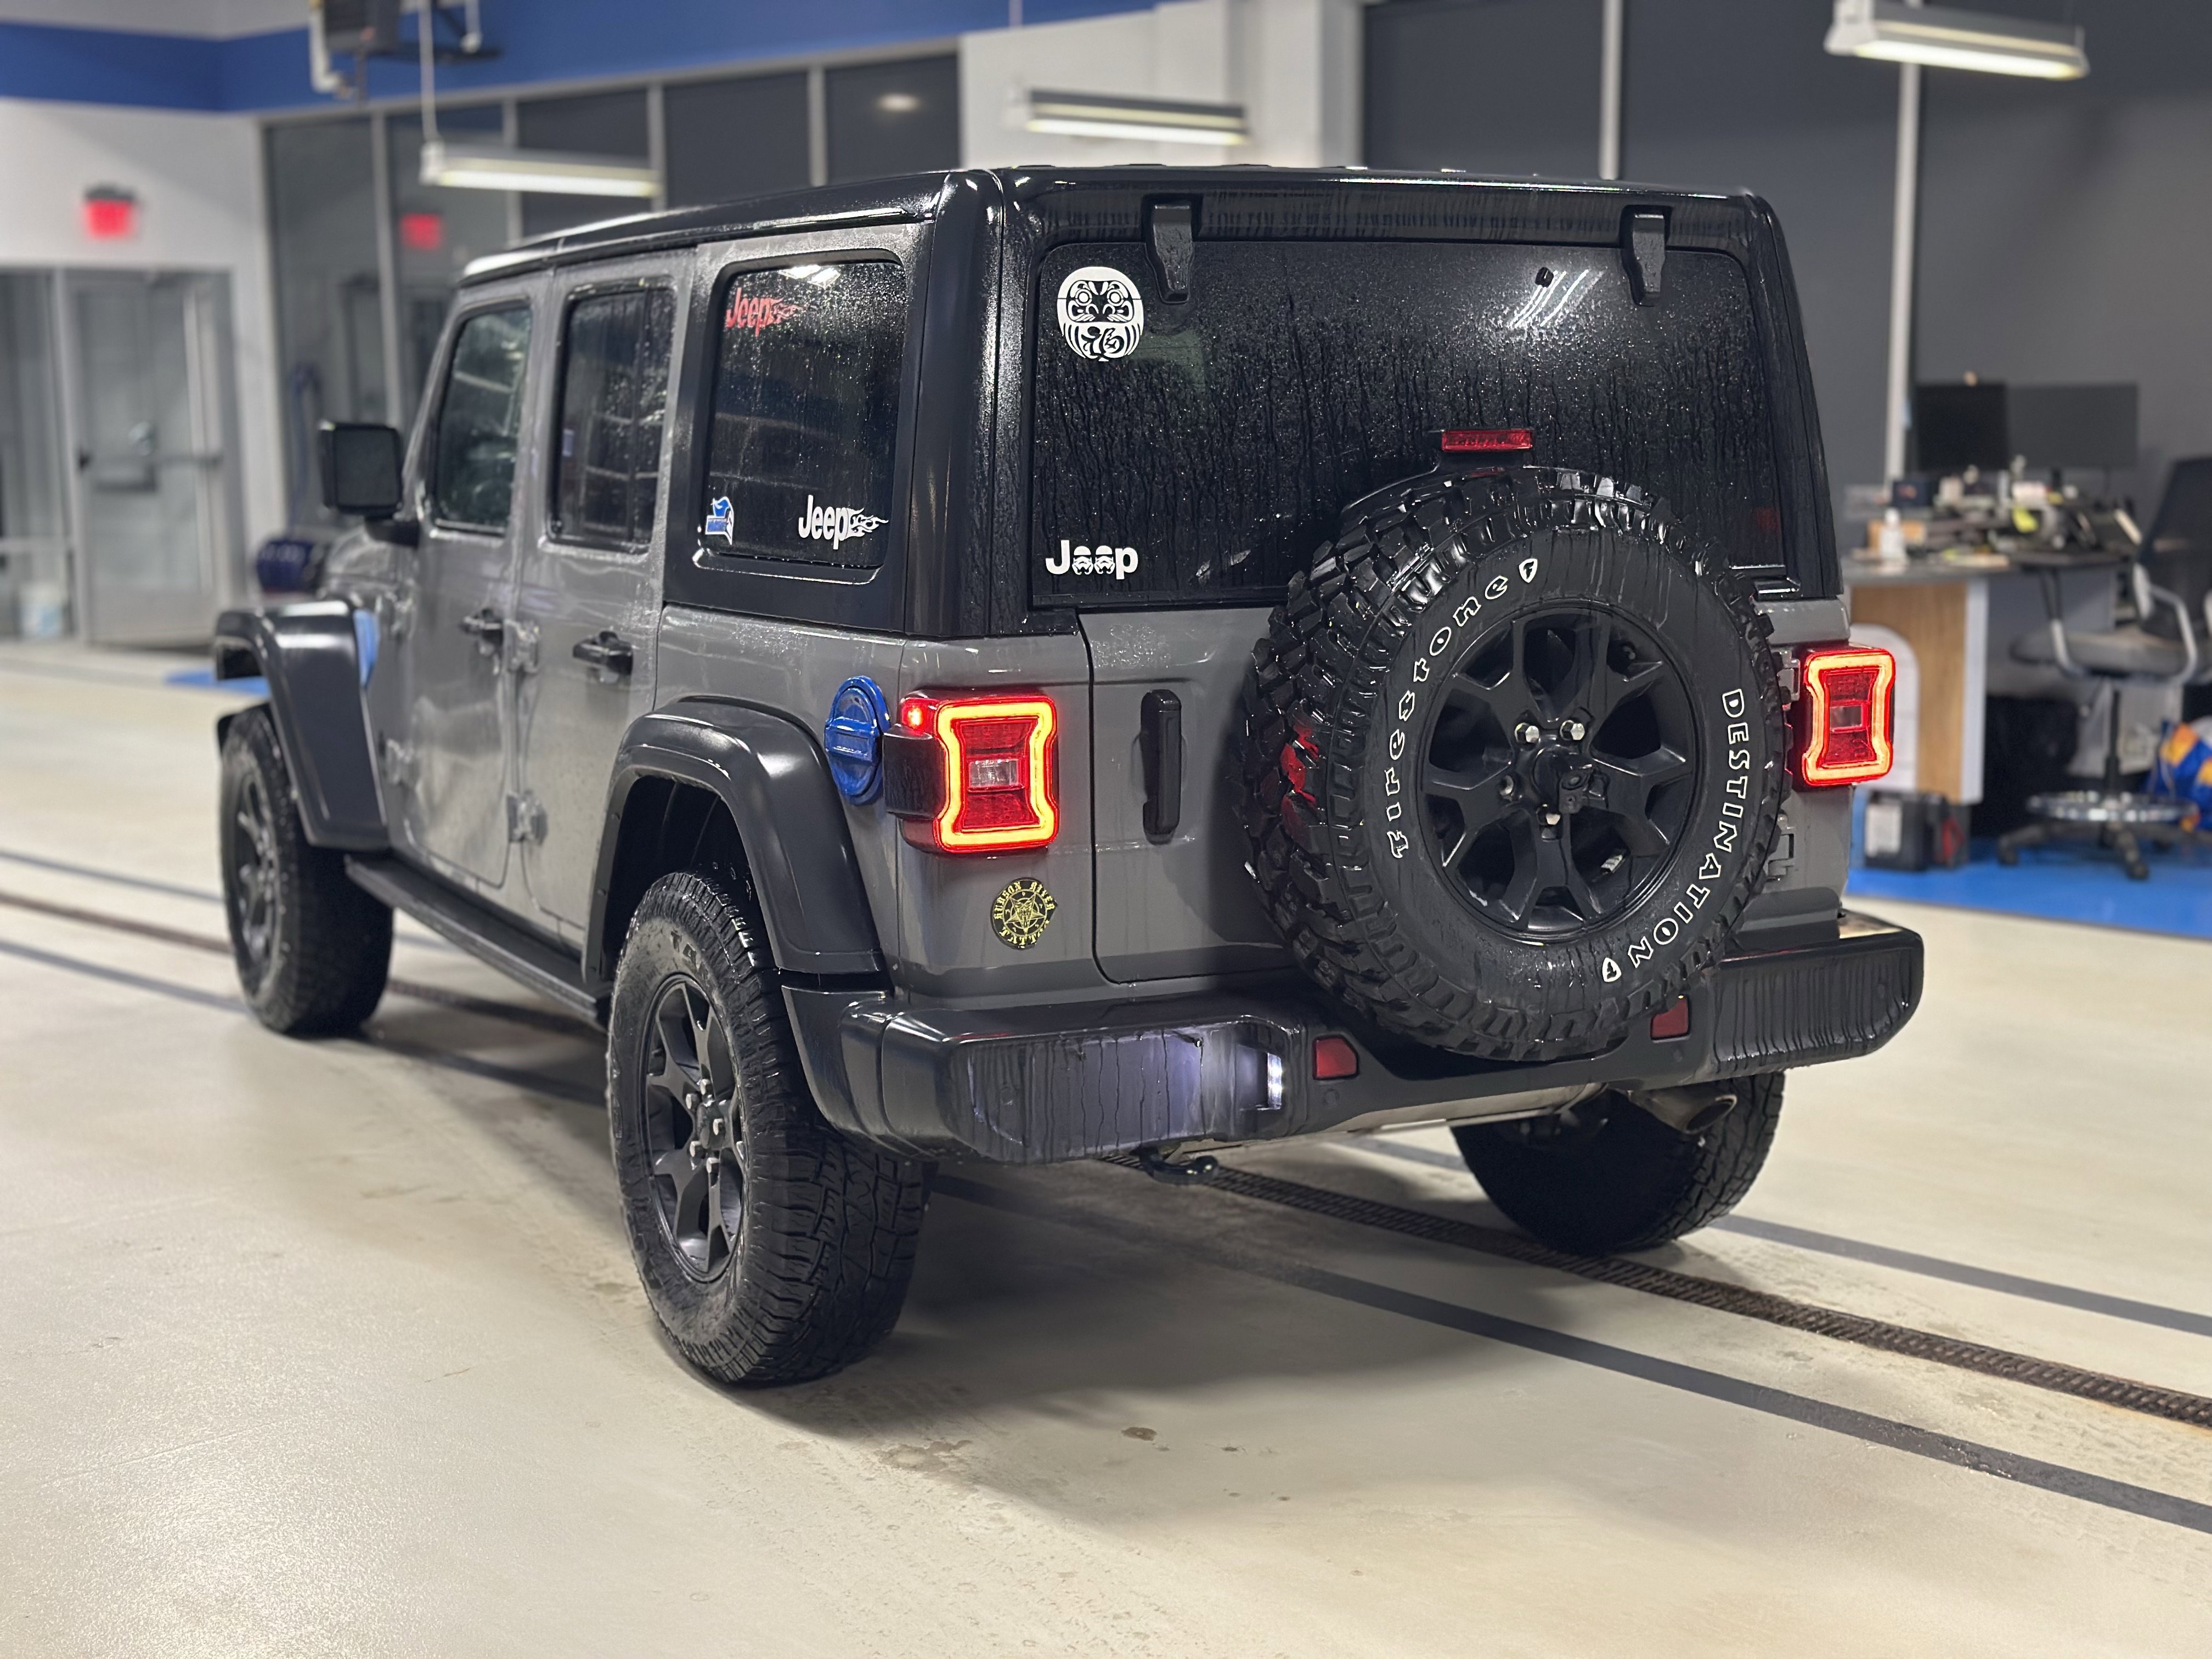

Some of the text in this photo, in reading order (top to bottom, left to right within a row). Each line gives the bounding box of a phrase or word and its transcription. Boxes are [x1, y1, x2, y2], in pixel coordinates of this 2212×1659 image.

[725, 287, 770, 337] Jeep
[799, 495, 849, 549] Jeep
[1628, 689, 1750, 969] DESTINATION
[994, 882, 1055, 919] HUDSON RIVER
